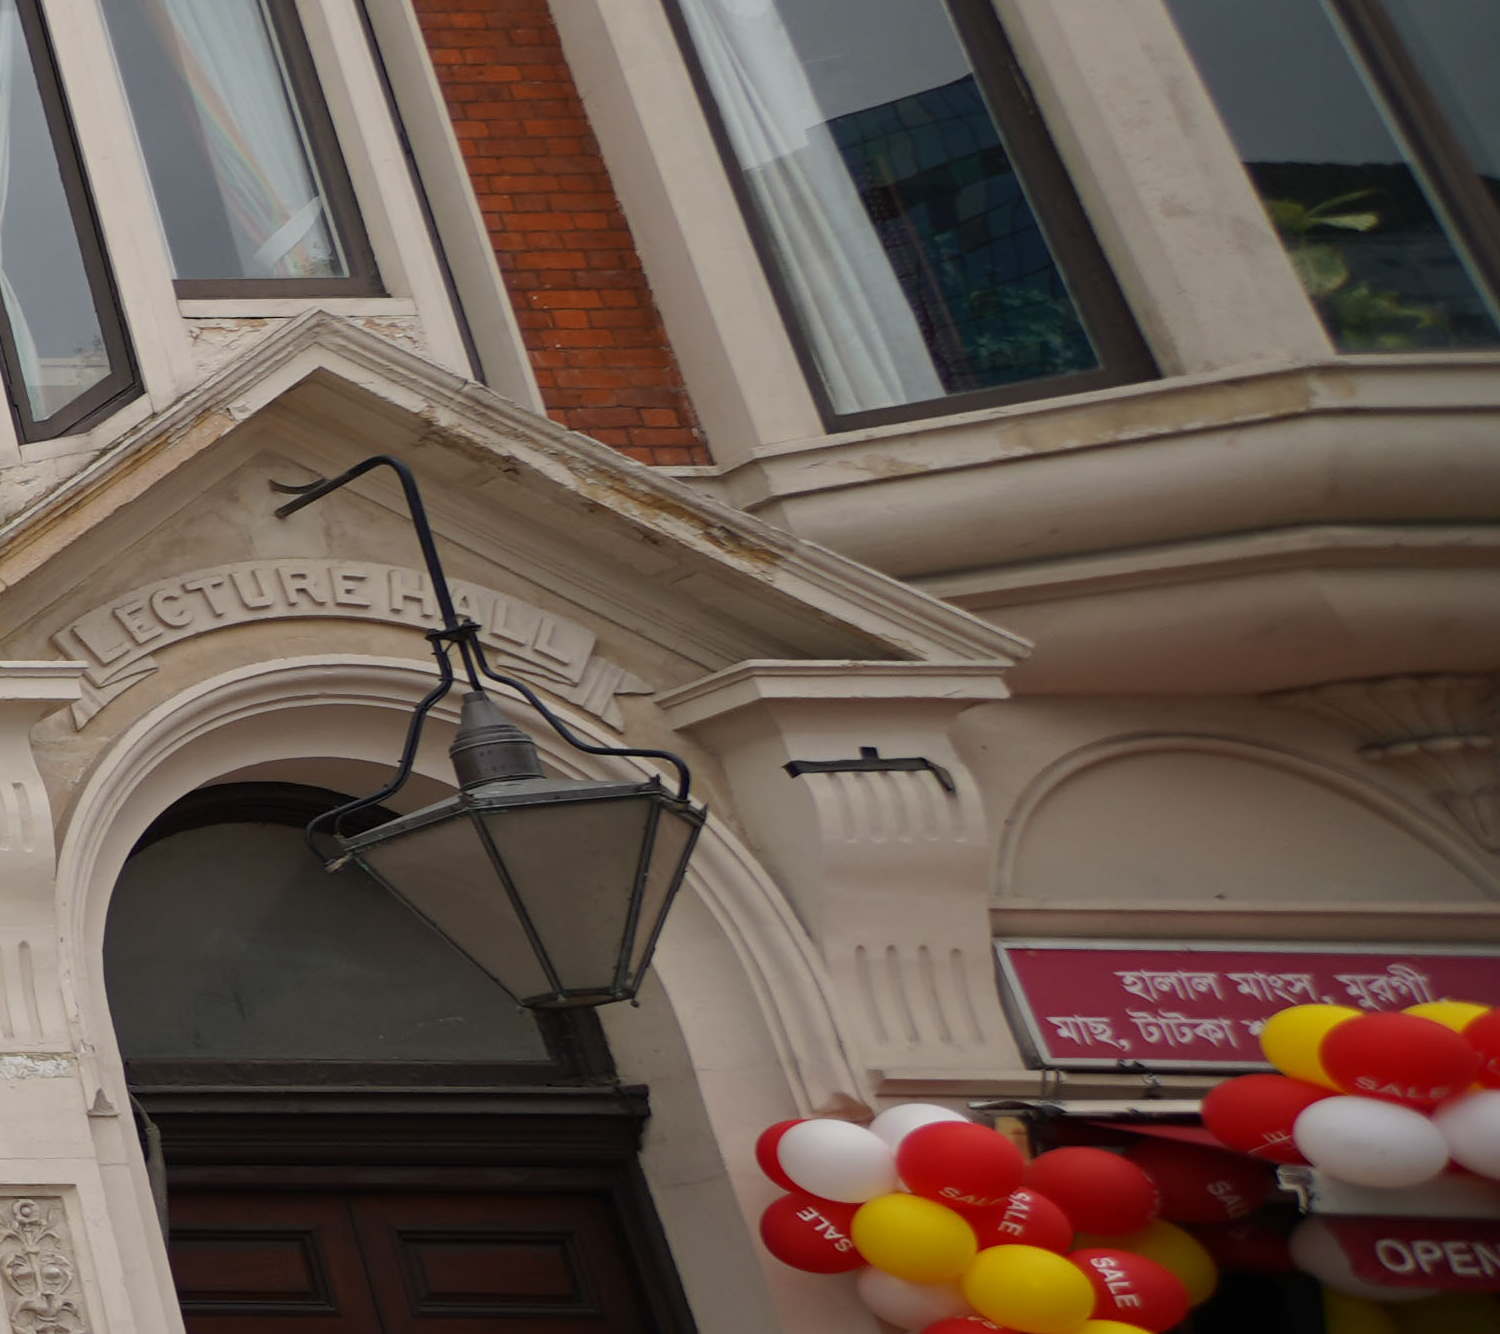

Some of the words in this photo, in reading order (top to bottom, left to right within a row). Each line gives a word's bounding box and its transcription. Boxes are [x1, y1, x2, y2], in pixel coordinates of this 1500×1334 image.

[70, 567, 374, 665] LECTURE
[389, 569, 572, 667] HALL
[1113, 969, 1225, 1002] হালাল
[1355, 1075, 1449, 1099] SALE
[797, 1206, 853, 1253] SALE
[998, 1191, 1032, 1236] SALE
[1089, 1256, 1142, 1309] SALE
